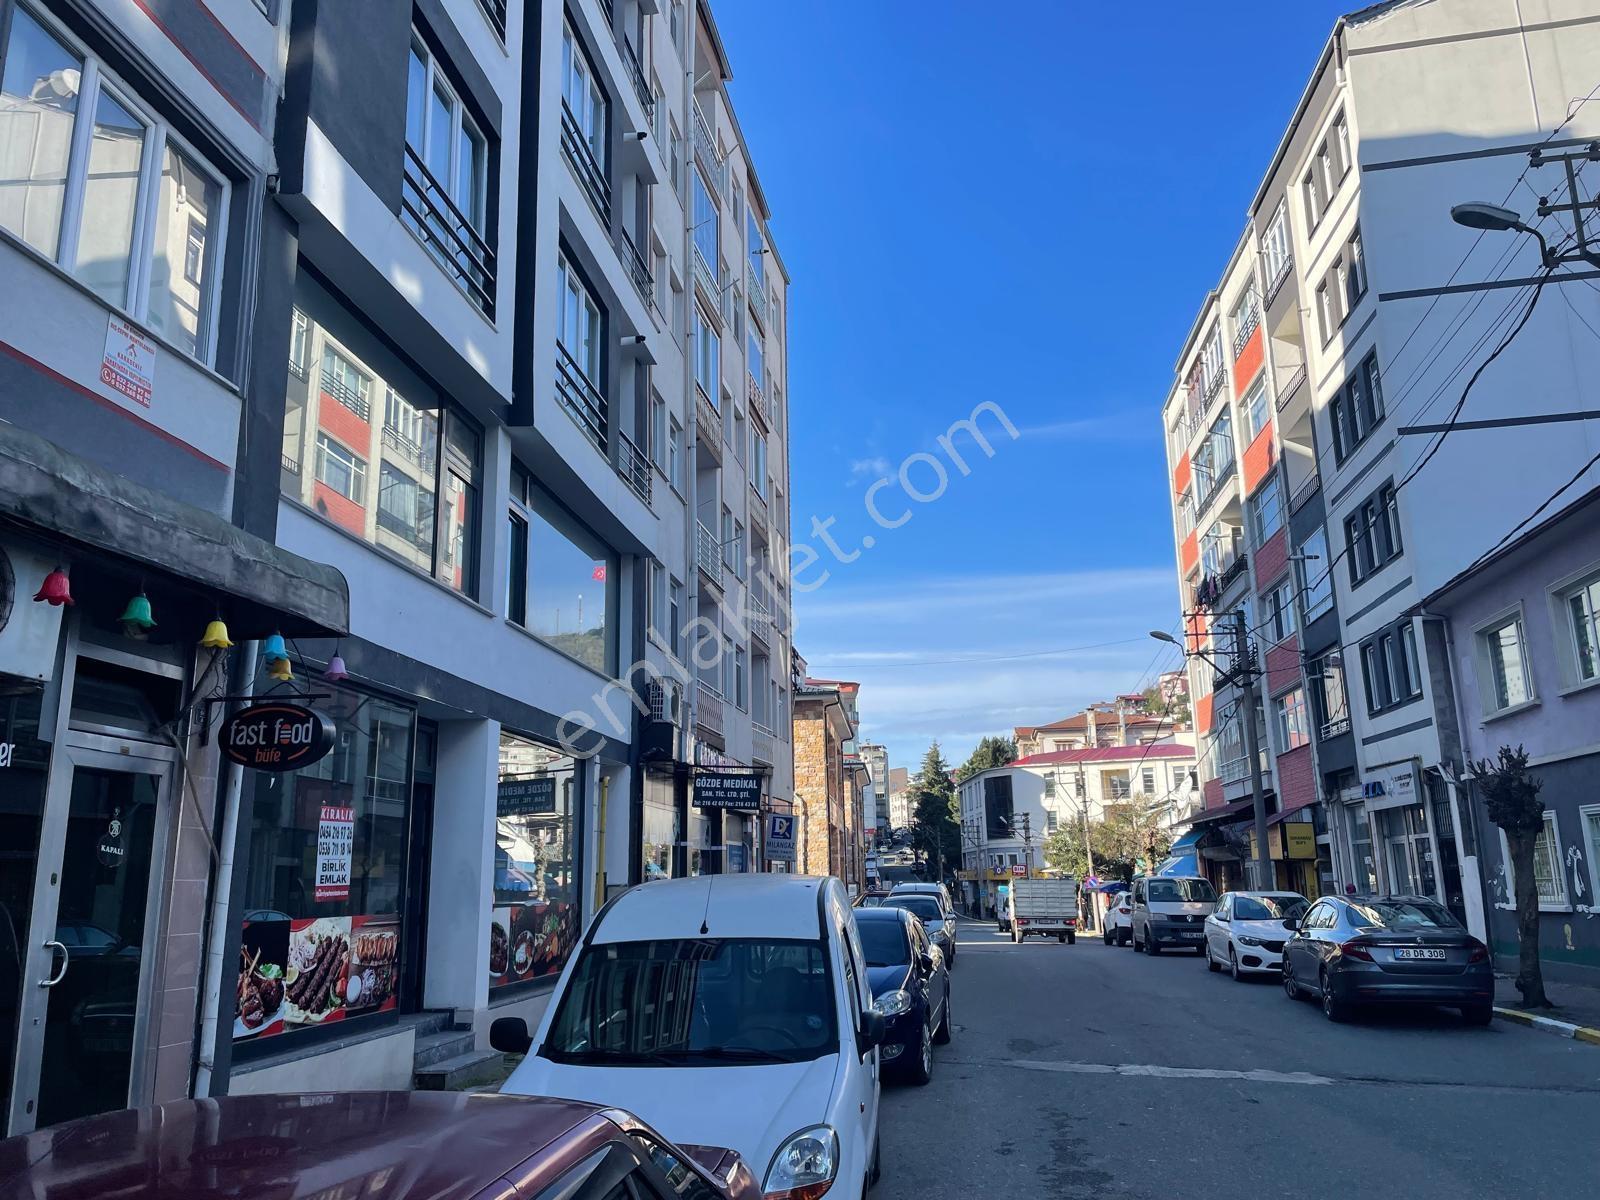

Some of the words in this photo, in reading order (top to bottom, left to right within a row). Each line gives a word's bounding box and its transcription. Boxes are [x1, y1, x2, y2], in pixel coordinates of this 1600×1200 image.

[230, 720, 267, 745] fast
[274, 717, 314, 745] food
[255, 747, 281, 763] büfe
[695, 776, 721, 788] GÖZDE
[723, 777, 758, 789] MEDİKAL
[321, 807, 354, 821] KİRALIK
[101, 844, 123, 856] KAPALI
[322, 860, 346, 872] BİRLİK
[320, 875, 347, 884] EMLAK
[1400, 949, 1411, 958] 28
[1413, 949, 1425, 958] DR
